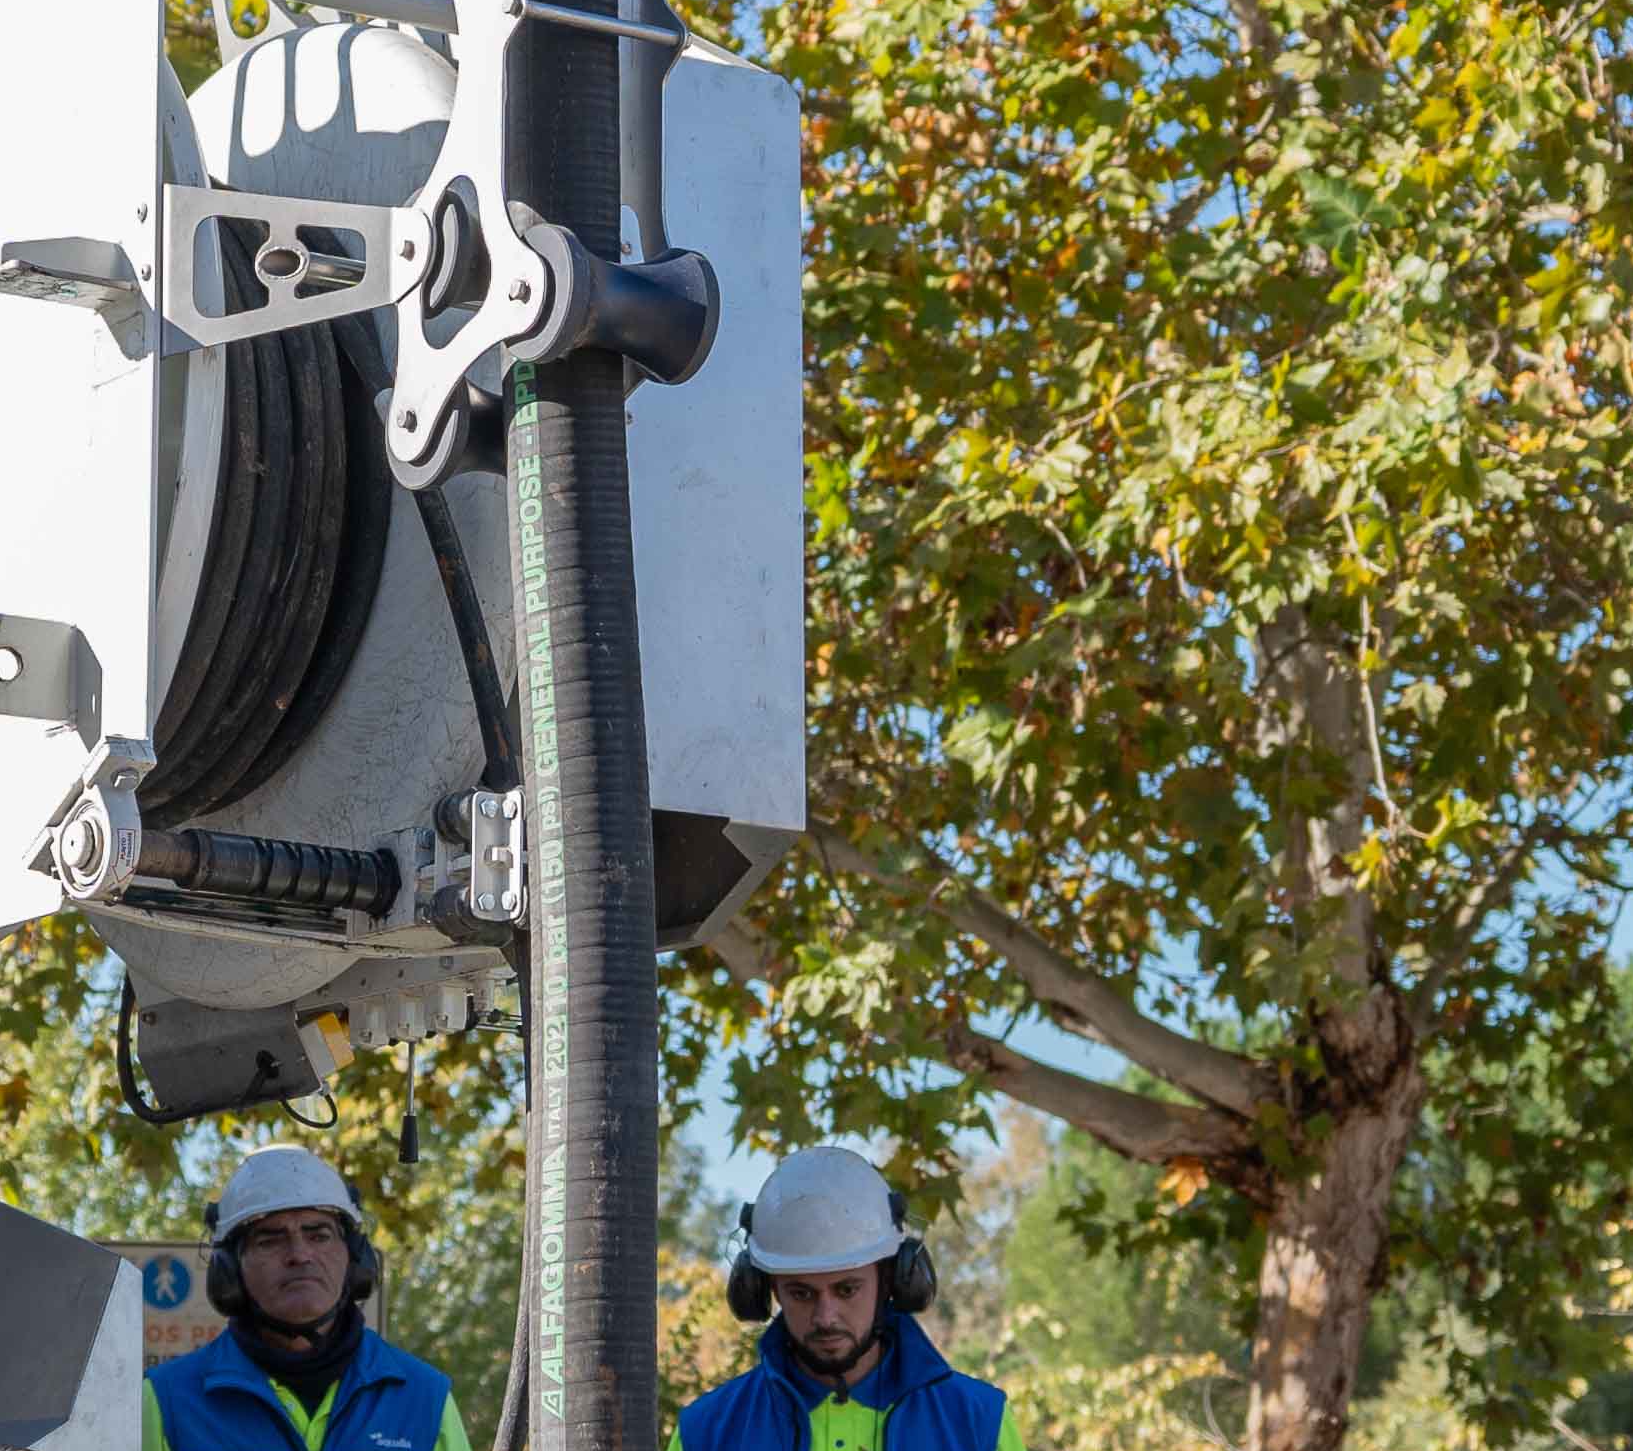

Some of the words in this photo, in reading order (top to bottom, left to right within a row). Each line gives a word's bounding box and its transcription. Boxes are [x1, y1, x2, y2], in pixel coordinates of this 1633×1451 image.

[517, 454, 549, 613] PURPOSE
[526, 619, 560, 778] GENERAL
[539, 839, 566, 903] (150
[545, 913, 568, 965] bar
[545, 975, 568, 1012] 10
[545, 1021, 566, 1073] 202
[547, 1085, 562, 1140] ITALY
[540, 1143, 566, 1385] ALFAGOMMA
